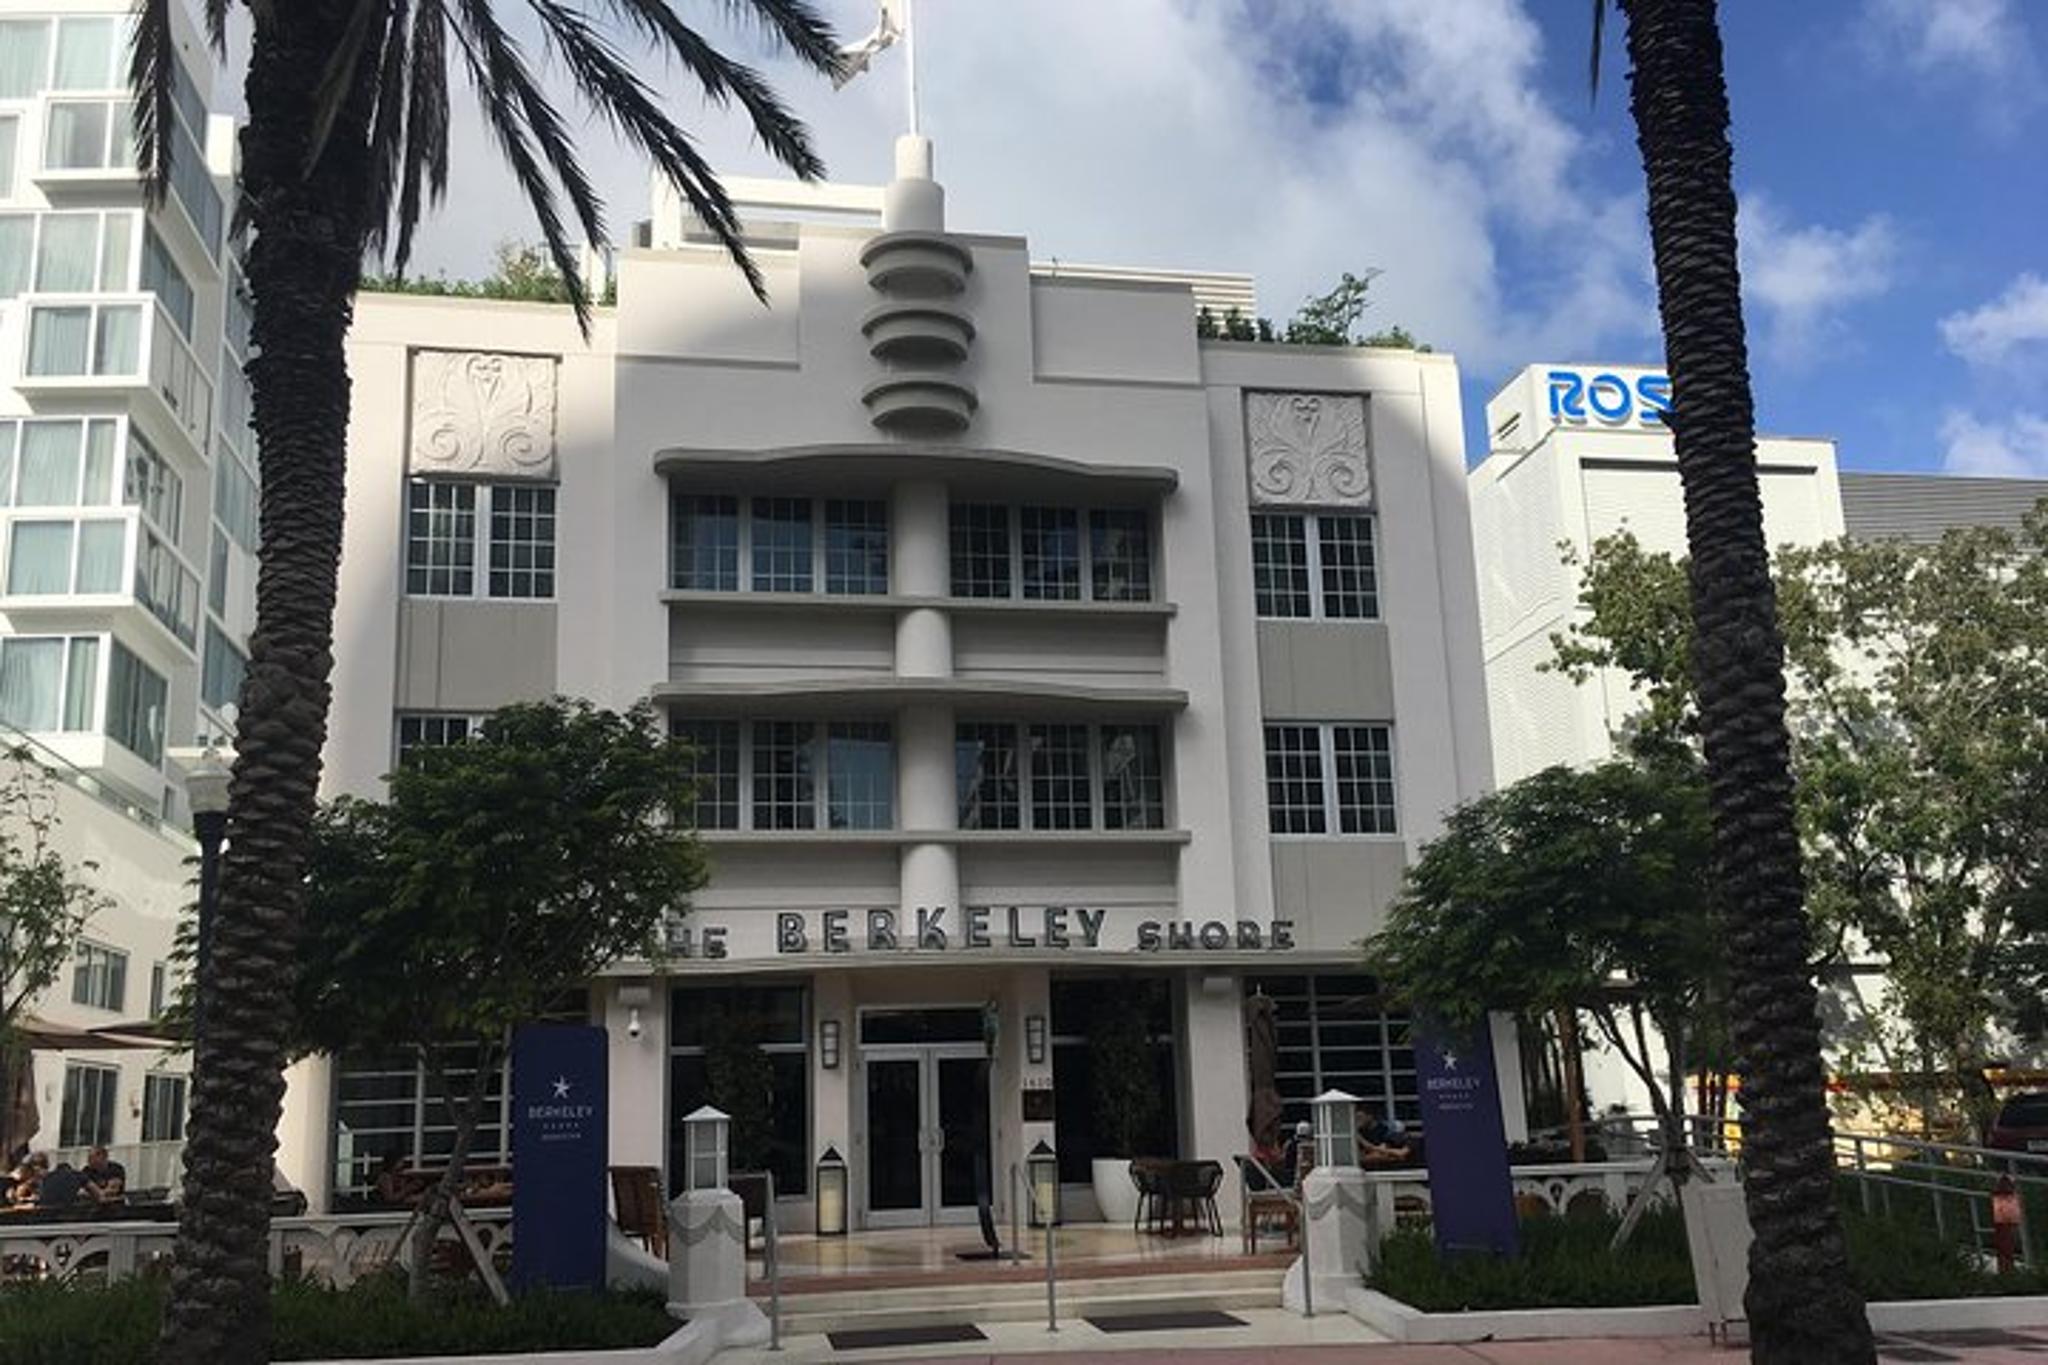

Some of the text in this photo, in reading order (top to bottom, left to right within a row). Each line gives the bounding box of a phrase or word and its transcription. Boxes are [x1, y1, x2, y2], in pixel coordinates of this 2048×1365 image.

[1548, 370, 1678, 422] ROS
[658, 907, 1296, 959] HE BERKELEY SHORE
[528, 1104, 594, 1119] BERKELEY
